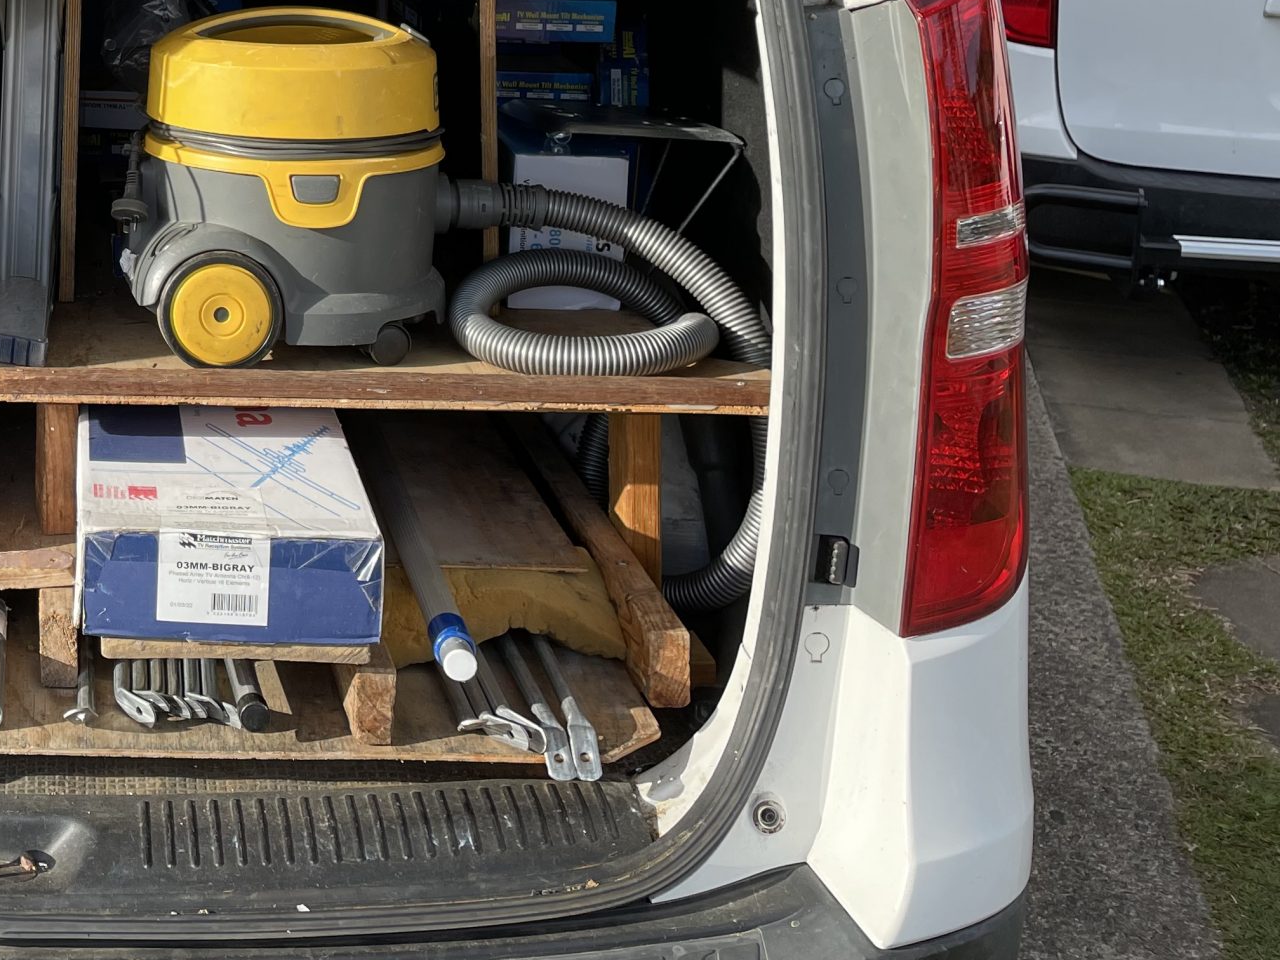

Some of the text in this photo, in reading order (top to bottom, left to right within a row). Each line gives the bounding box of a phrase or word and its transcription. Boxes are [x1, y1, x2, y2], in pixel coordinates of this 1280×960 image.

[518, 81, 540, 89] Mount
[196, 534, 252, 545] Matchmaster
[176, 561, 255, 573] 03MM-BIGRAY
